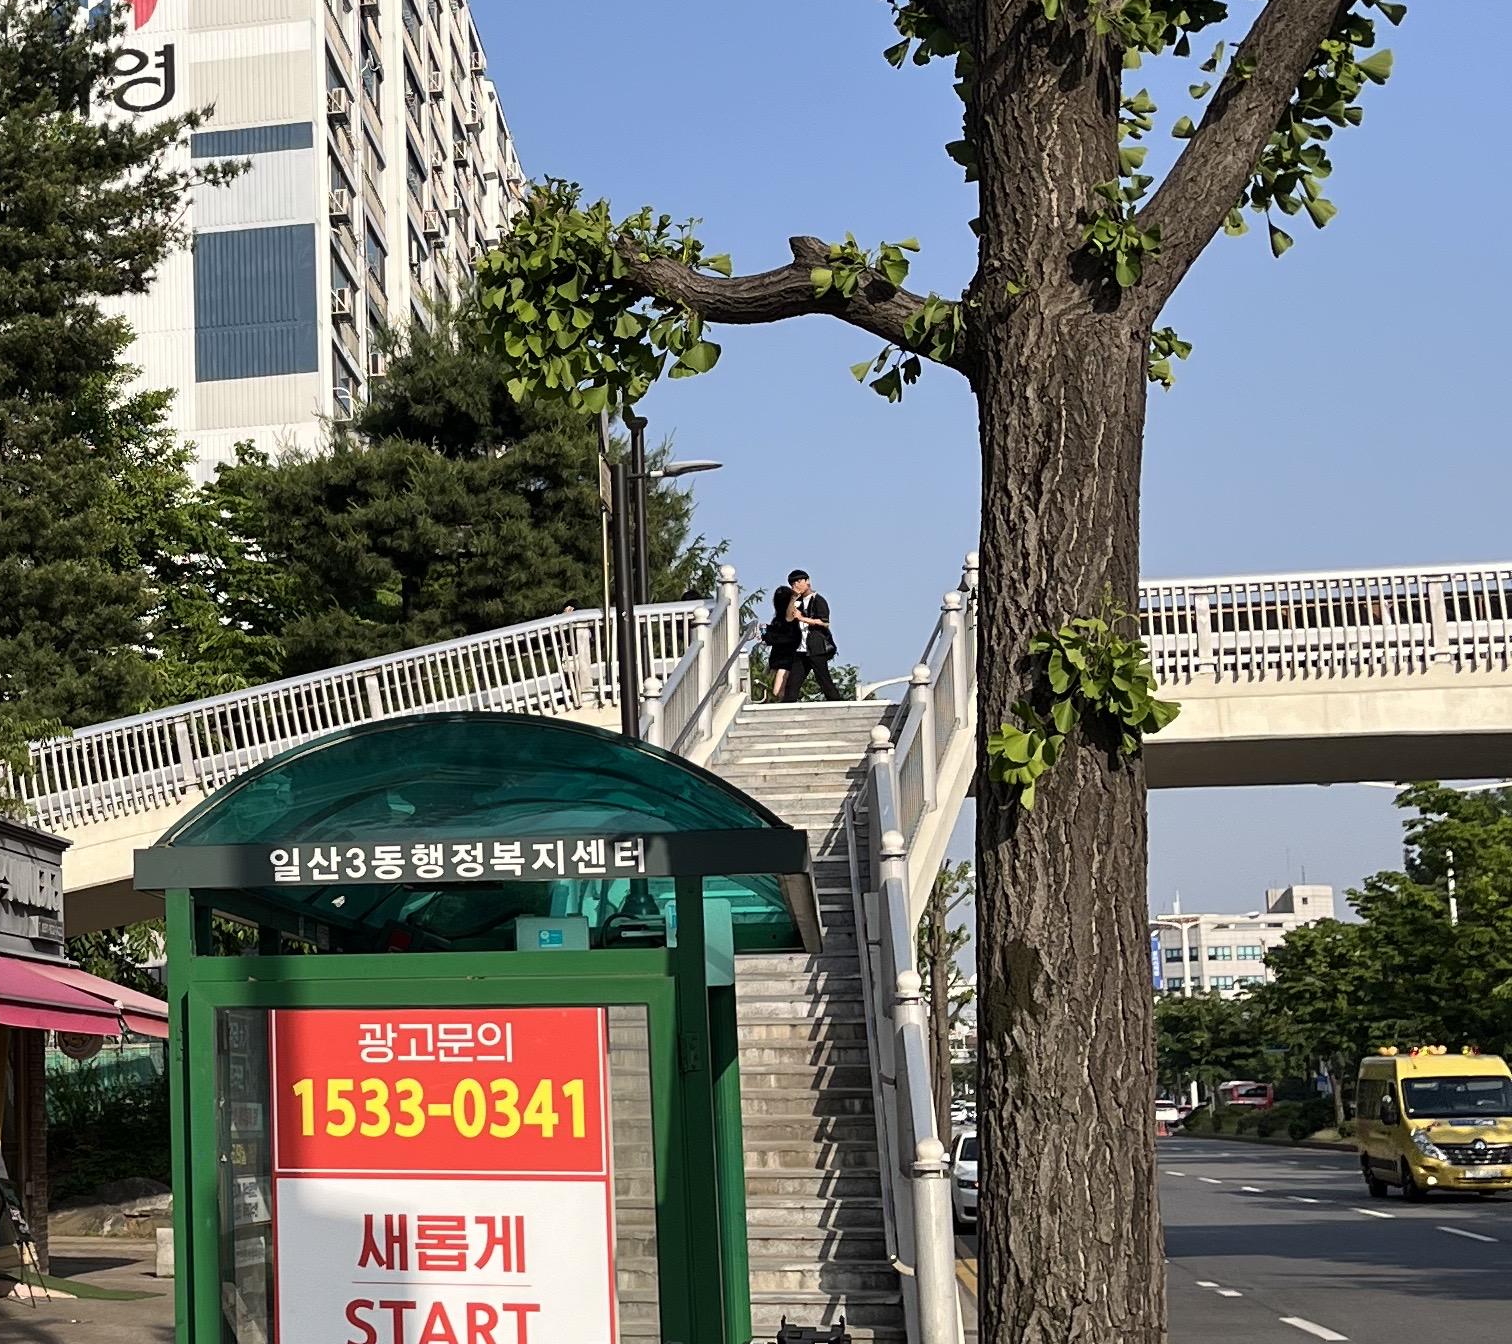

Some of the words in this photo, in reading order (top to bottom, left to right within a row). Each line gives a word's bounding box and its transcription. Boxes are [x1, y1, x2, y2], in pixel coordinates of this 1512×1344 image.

[269, 837, 646, 882] 일산3동행정복지센터
[358, 1021, 514, 1063] 광고문의
[292, 1076, 587, 1139] 1533-0341
[357, 1213, 527, 1274] 새롭게
